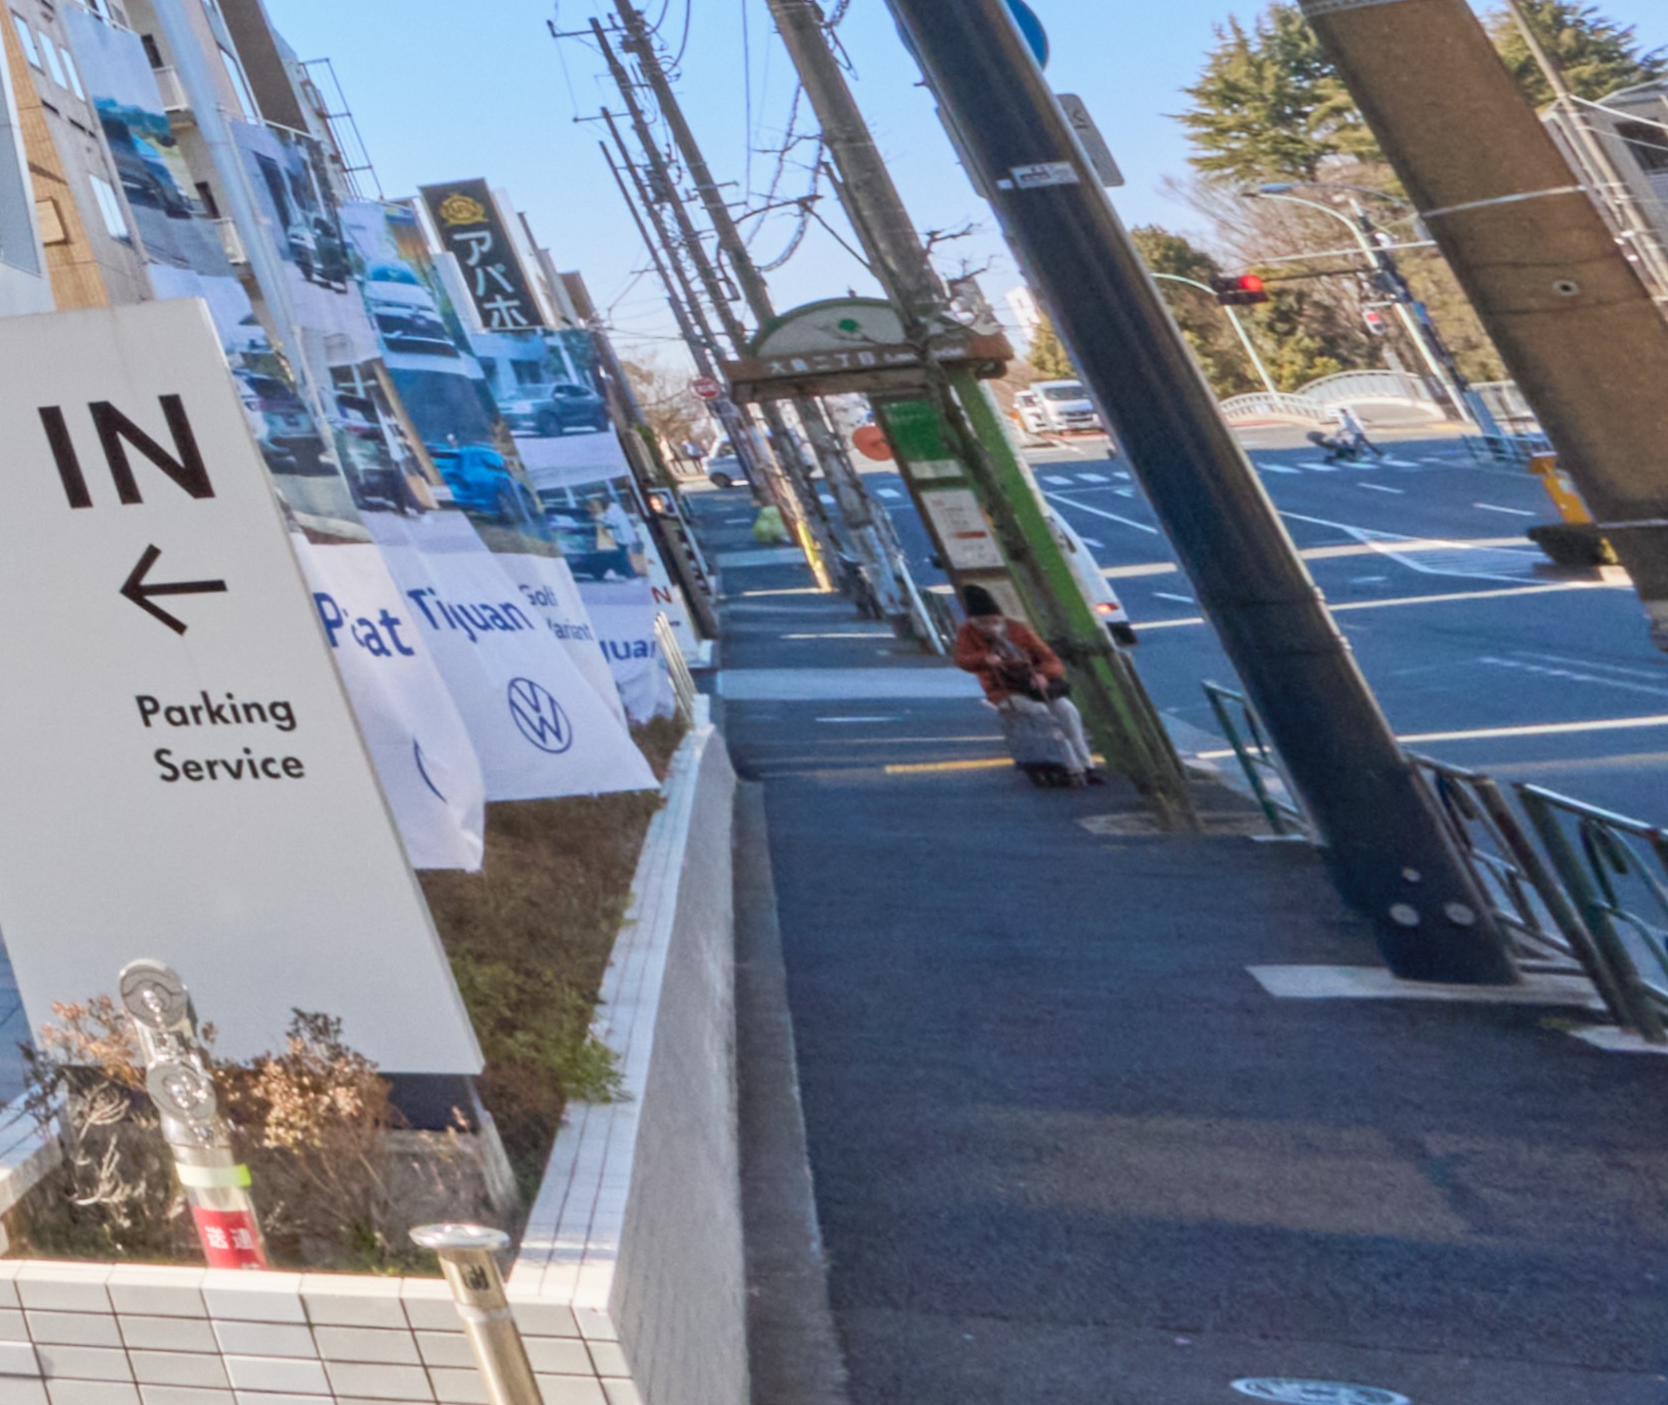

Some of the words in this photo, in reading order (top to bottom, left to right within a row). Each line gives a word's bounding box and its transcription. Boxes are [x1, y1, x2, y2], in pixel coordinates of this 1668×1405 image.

[38, 393, 215, 509] IN
[313, 592, 415, 657] Pat
[135, 690, 297, 732] Parking
[154, 747, 305, 782] Service
